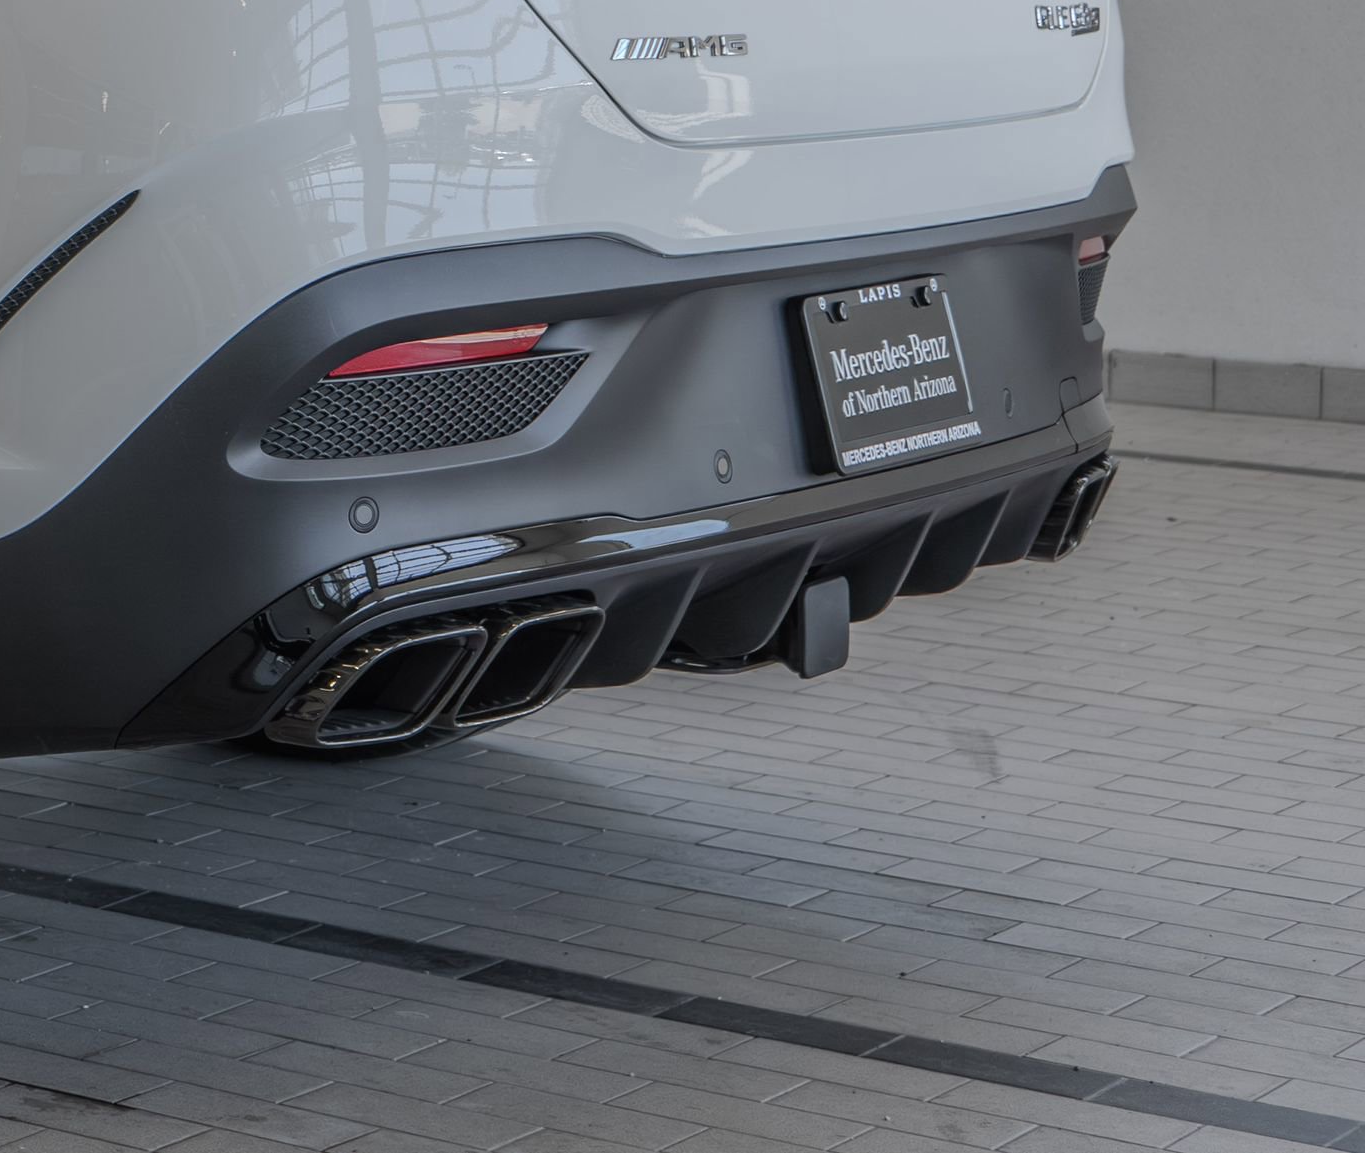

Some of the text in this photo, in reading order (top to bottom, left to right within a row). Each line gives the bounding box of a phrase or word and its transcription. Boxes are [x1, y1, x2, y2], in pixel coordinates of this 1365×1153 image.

[660, 33, 749, 60] AMG
[858, 284, 901, 304] LAPIS
[830, 334, 950, 383] Mercedes-Benz
[842, 375, 957, 418] of Northern Arizona
[841, 421, 982, 467] MERCEDES-BENZ NORTHERN ARIZONA
